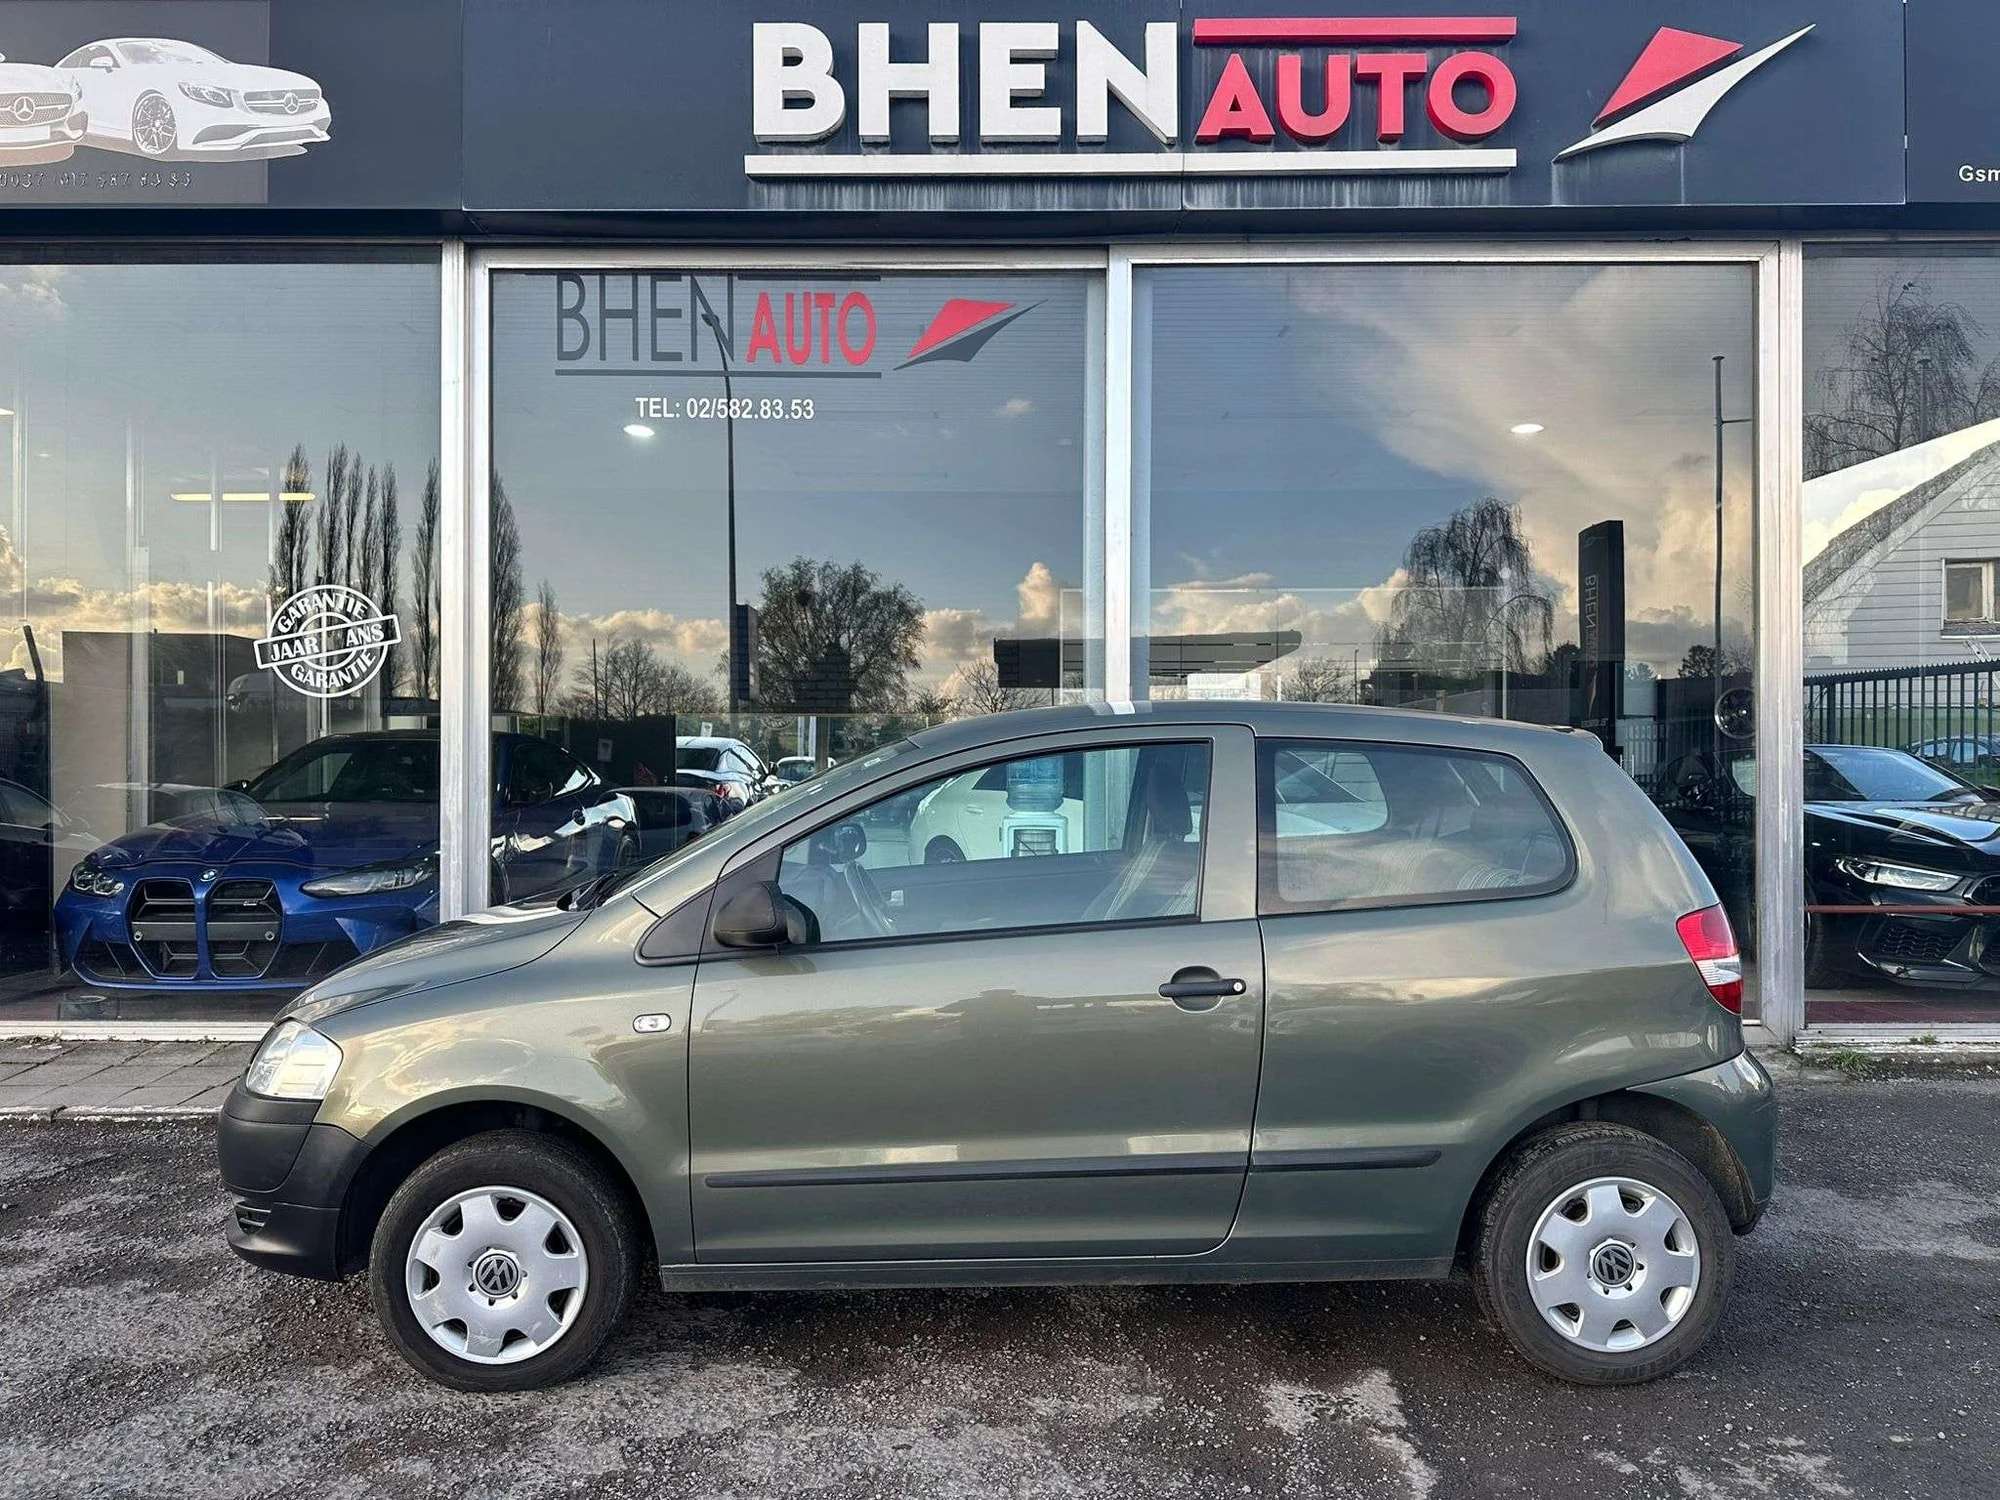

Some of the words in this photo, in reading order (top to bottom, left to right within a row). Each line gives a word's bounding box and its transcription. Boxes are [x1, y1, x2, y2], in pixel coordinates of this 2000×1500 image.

[753, 20, 1178, 145] BHEN
[1196, 52, 1517, 144] AUTO
[1959, 165, 2000, 182] Gsm
[556, 274, 735, 362] BHEN
[745, 291, 877, 366] AUTO
[635, 397, 680, 418] TEL:
[686, 398, 815, 420] 02/582.83.53
[277, 591, 369, 634] GARANTIE
[270, 636, 320, 662] JAAR
[345, 623, 385, 648] ANS
[290, 652, 377, 689] GARANTIE
